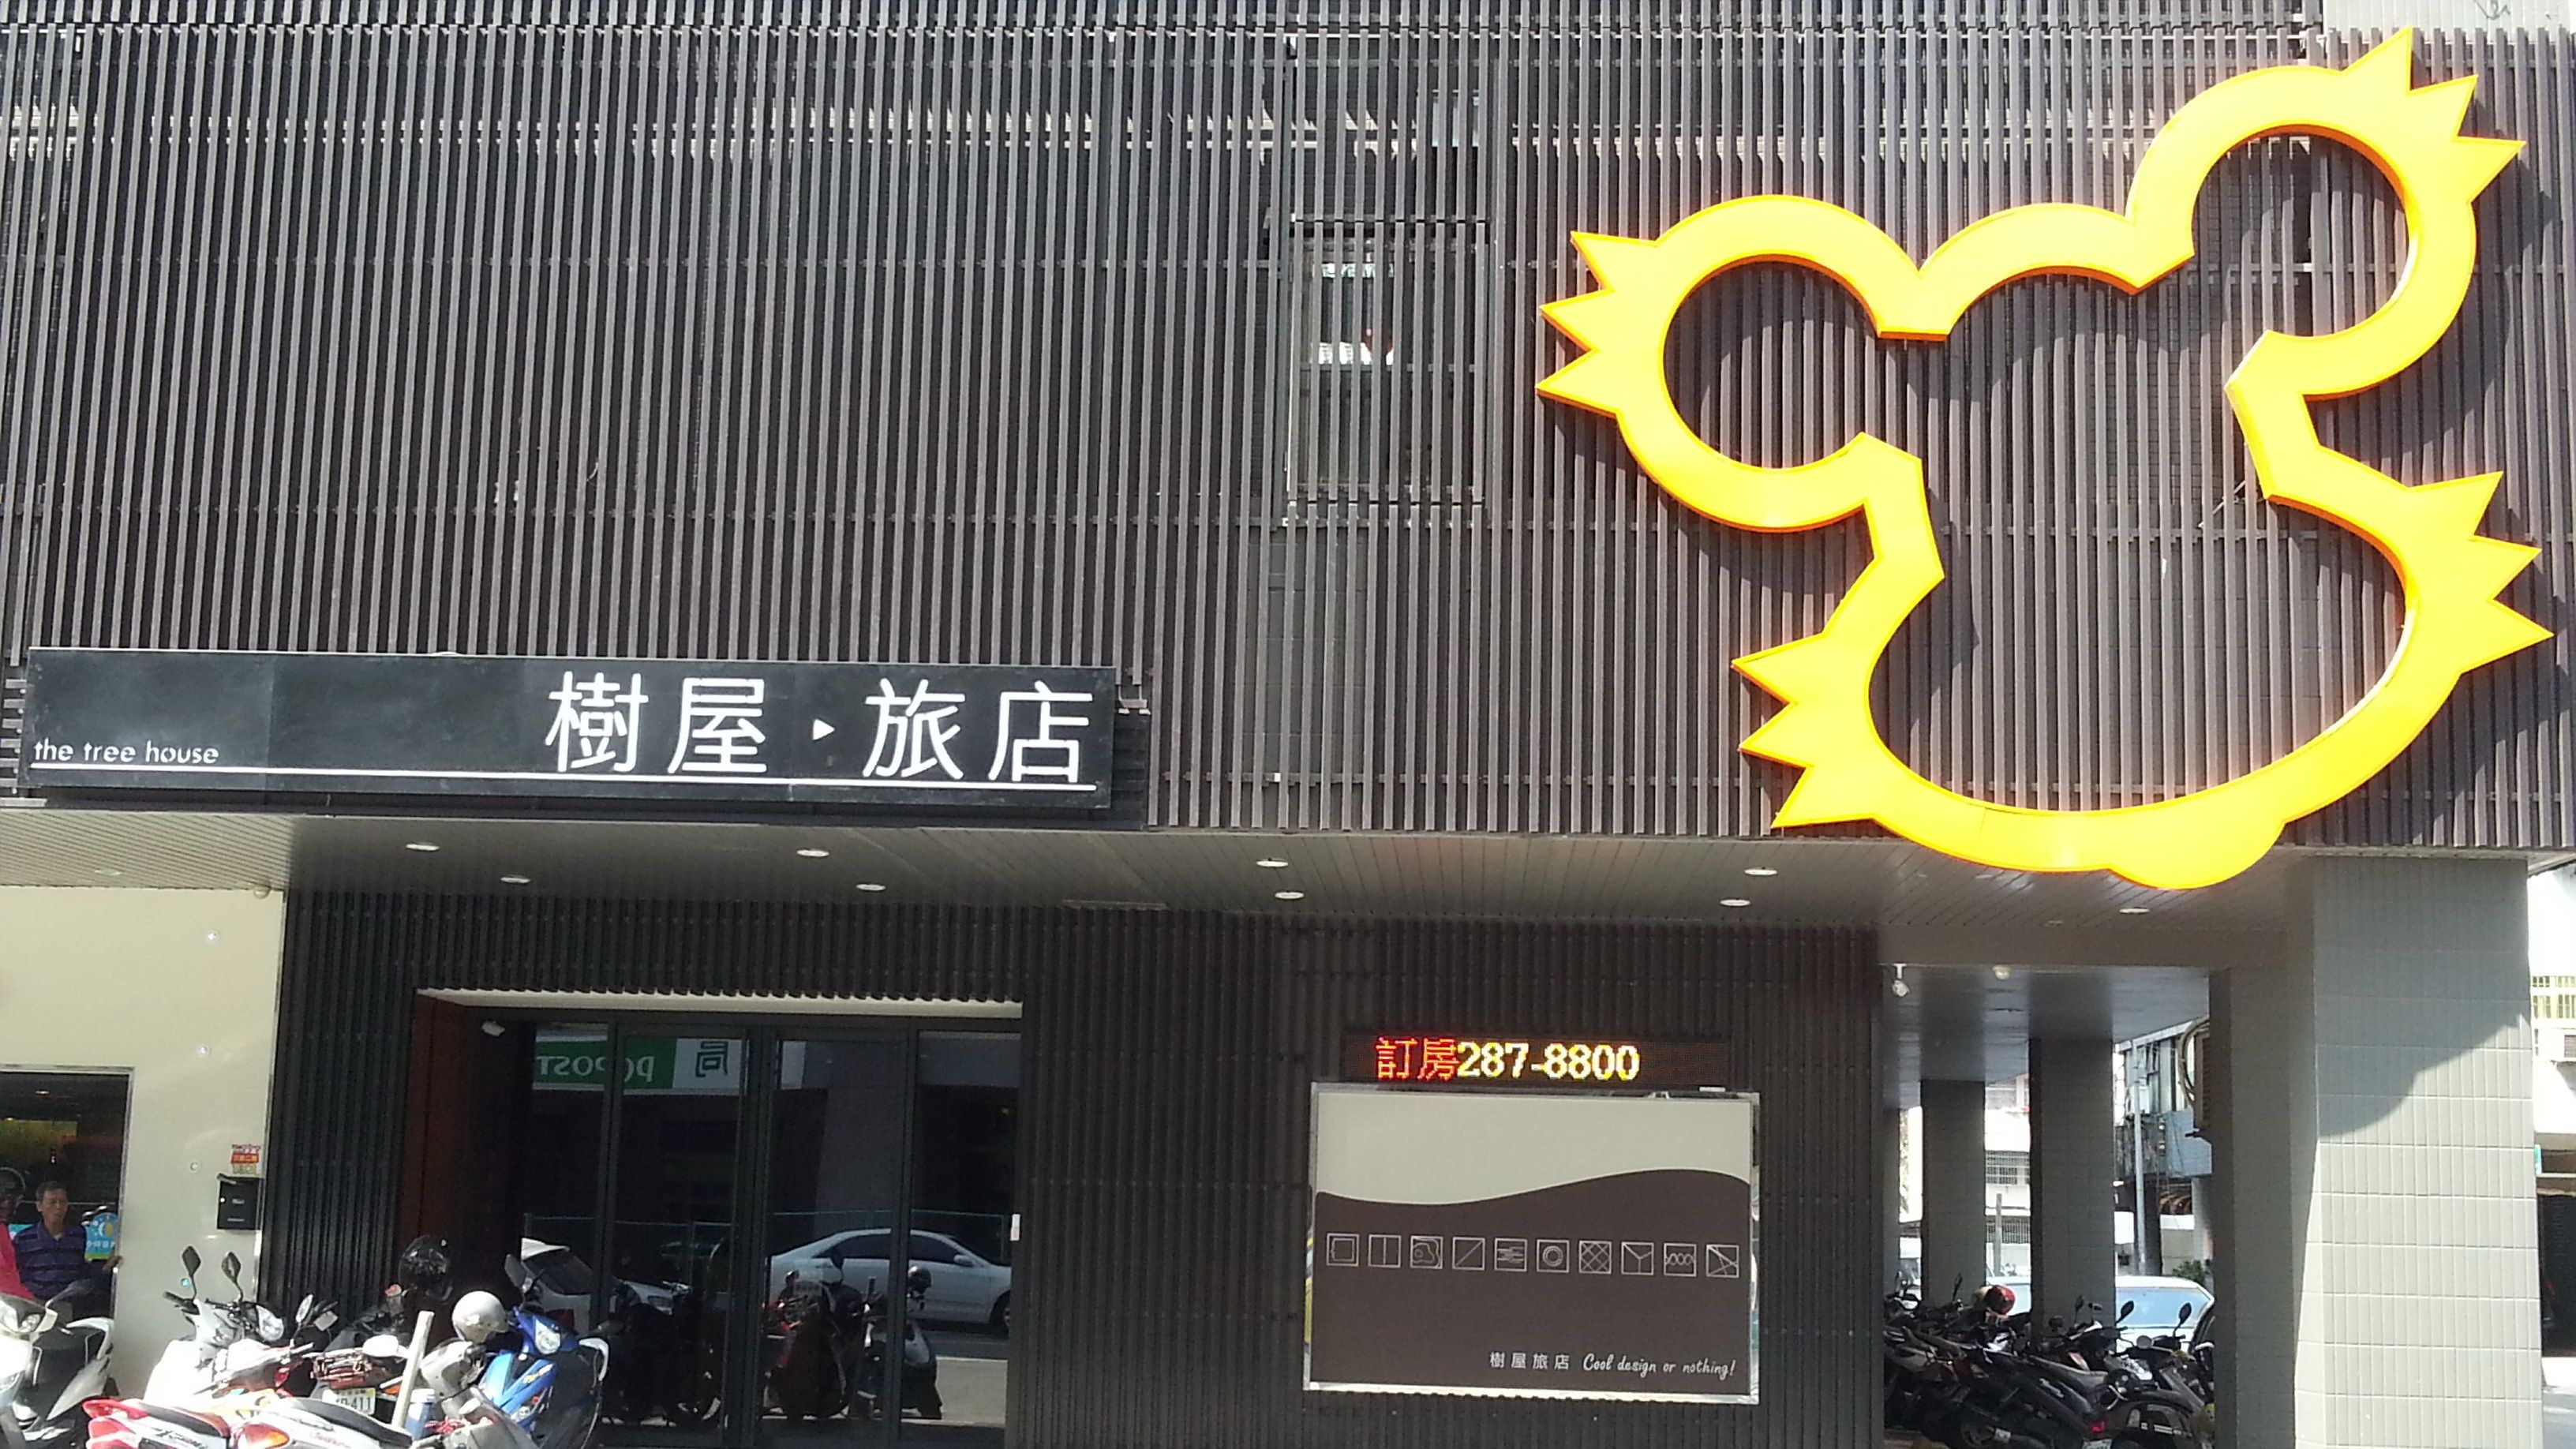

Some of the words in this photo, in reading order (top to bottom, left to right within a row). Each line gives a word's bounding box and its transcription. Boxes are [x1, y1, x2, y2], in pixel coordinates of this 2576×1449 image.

[33, 737, 73, 762] the
[84, 742, 136, 762] tree
[145, 739, 219, 764] house
[1489, 1352, 1570, 1370] 樹屋旅店
[1582, 1353, 1614, 1372] Cool
[1617, 1357, 1657, 1379] design
[1662, 1362, 1676, 1373] or
[1682, 1357, 1737, 1381] nothing!
